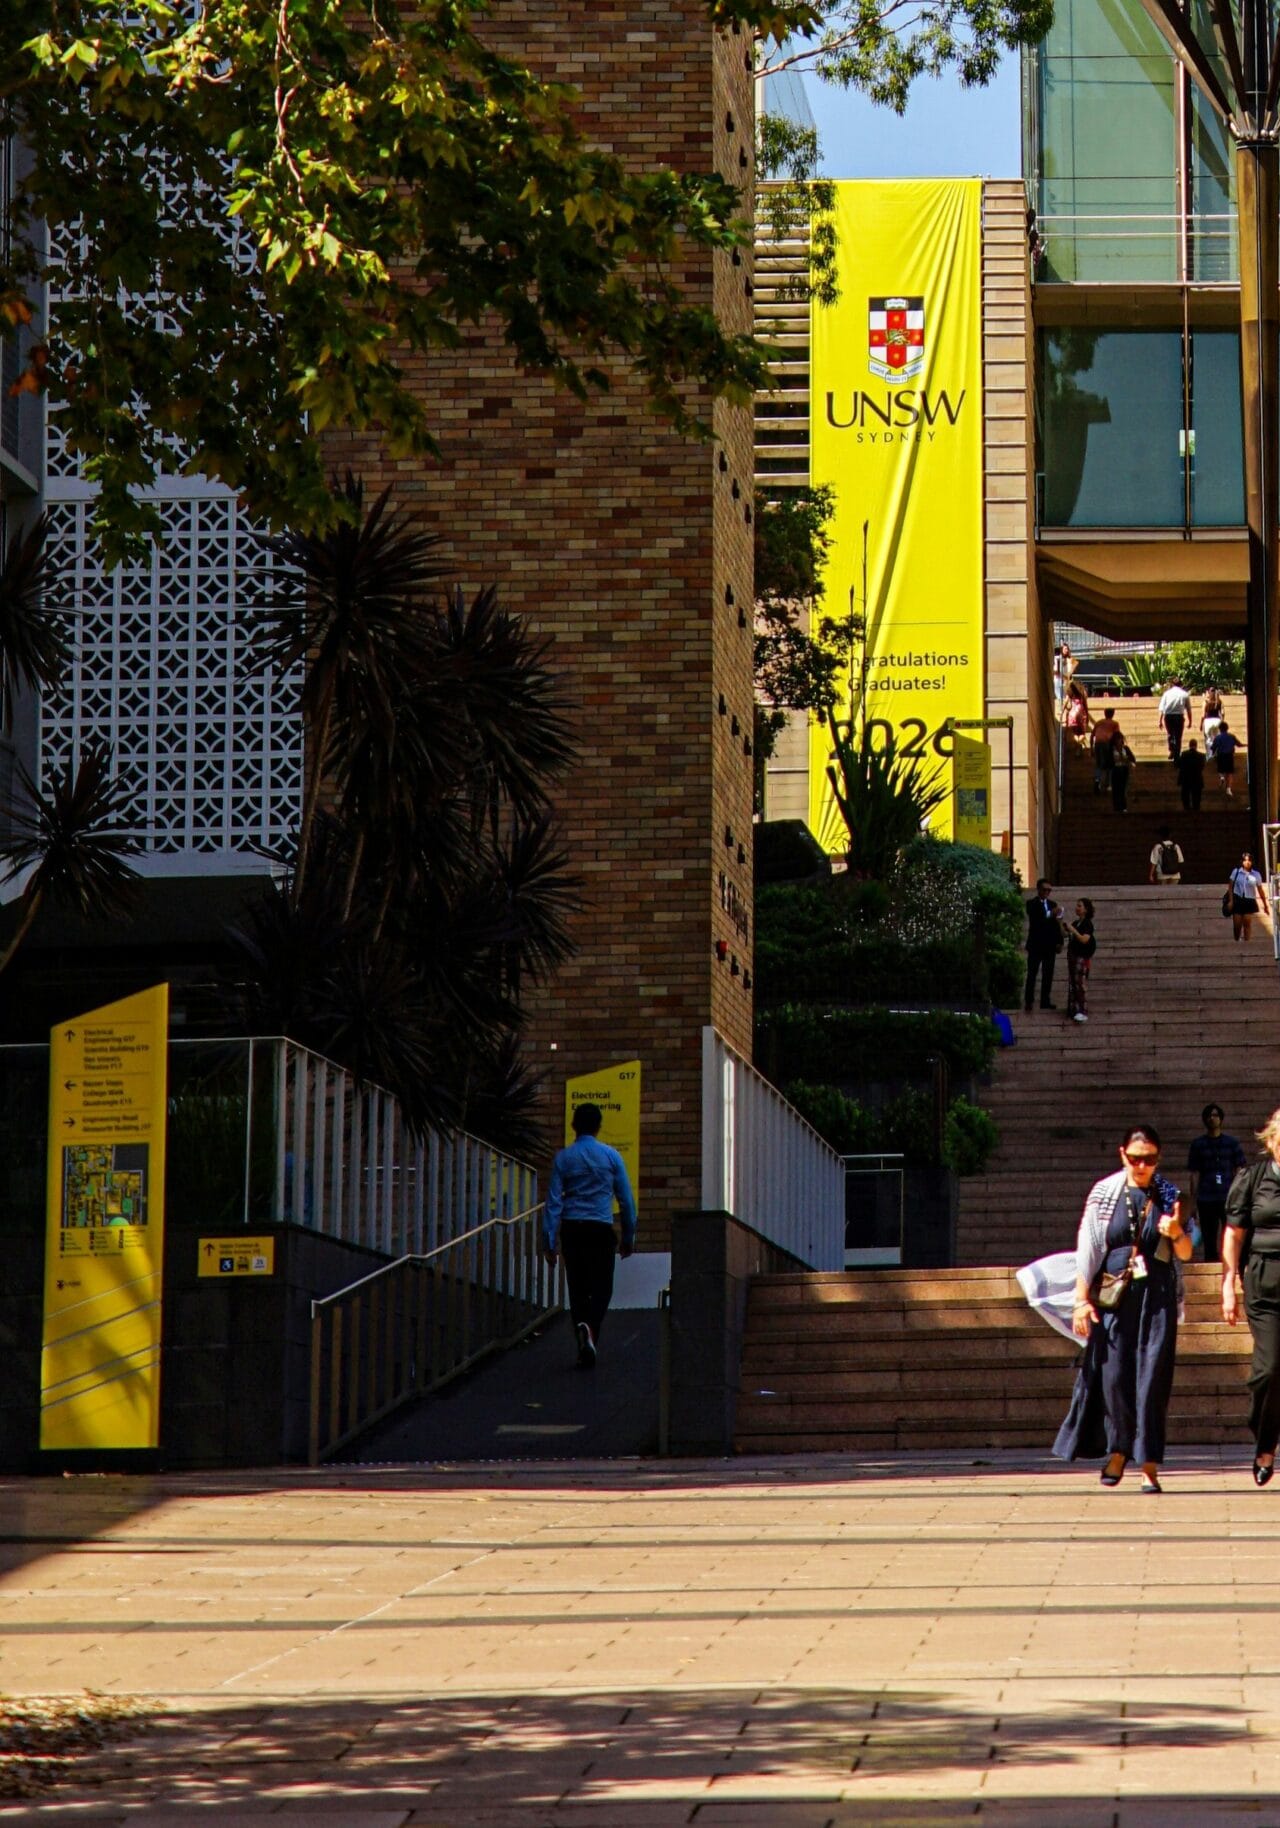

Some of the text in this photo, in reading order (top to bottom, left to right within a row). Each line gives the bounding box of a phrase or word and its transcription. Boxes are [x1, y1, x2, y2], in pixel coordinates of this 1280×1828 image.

[826, 389, 966, 428] UNSW
[857, 431, 935, 443] SYDNEY
[838, 652, 968, 671] ongratulations
[619, 1072, 636, 1080] G17
[571, 1091, 610, 1099] Electrical
